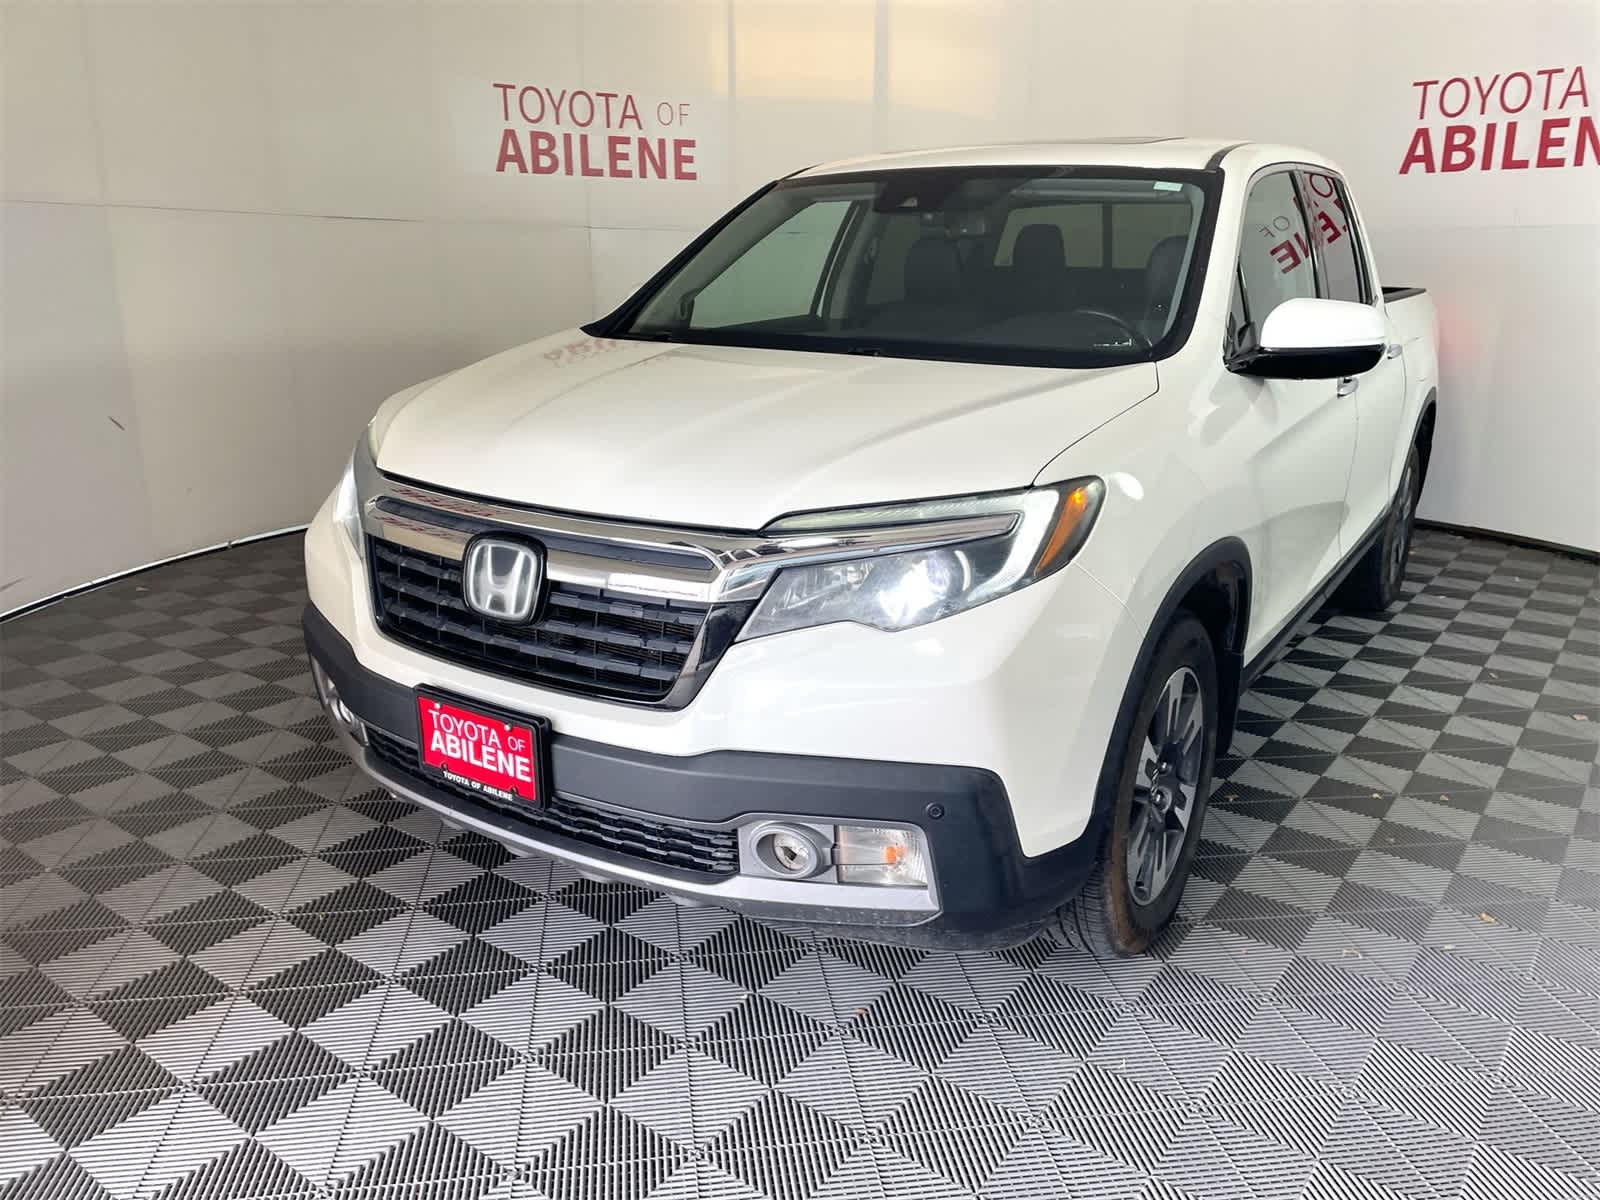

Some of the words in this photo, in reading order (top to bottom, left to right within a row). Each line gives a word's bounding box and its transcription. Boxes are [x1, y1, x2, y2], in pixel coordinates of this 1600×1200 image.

[492, 83, 643, 129] TOYOTA
[656, 101, 690, 127] OF
[1412, 66, 1589, 120] TOYOTA
[495, 128, 698, 180] ABILENE
[428, 709, 502, 749] TOYOTA
[507, 735, 526, 752] OF
[430, 729, 532, 783] ABILENE
[443, 770, 470, 787] TOYOTA
[471, 780, 482, 790] OF
[483, 785, 513, 801] ABILENE
